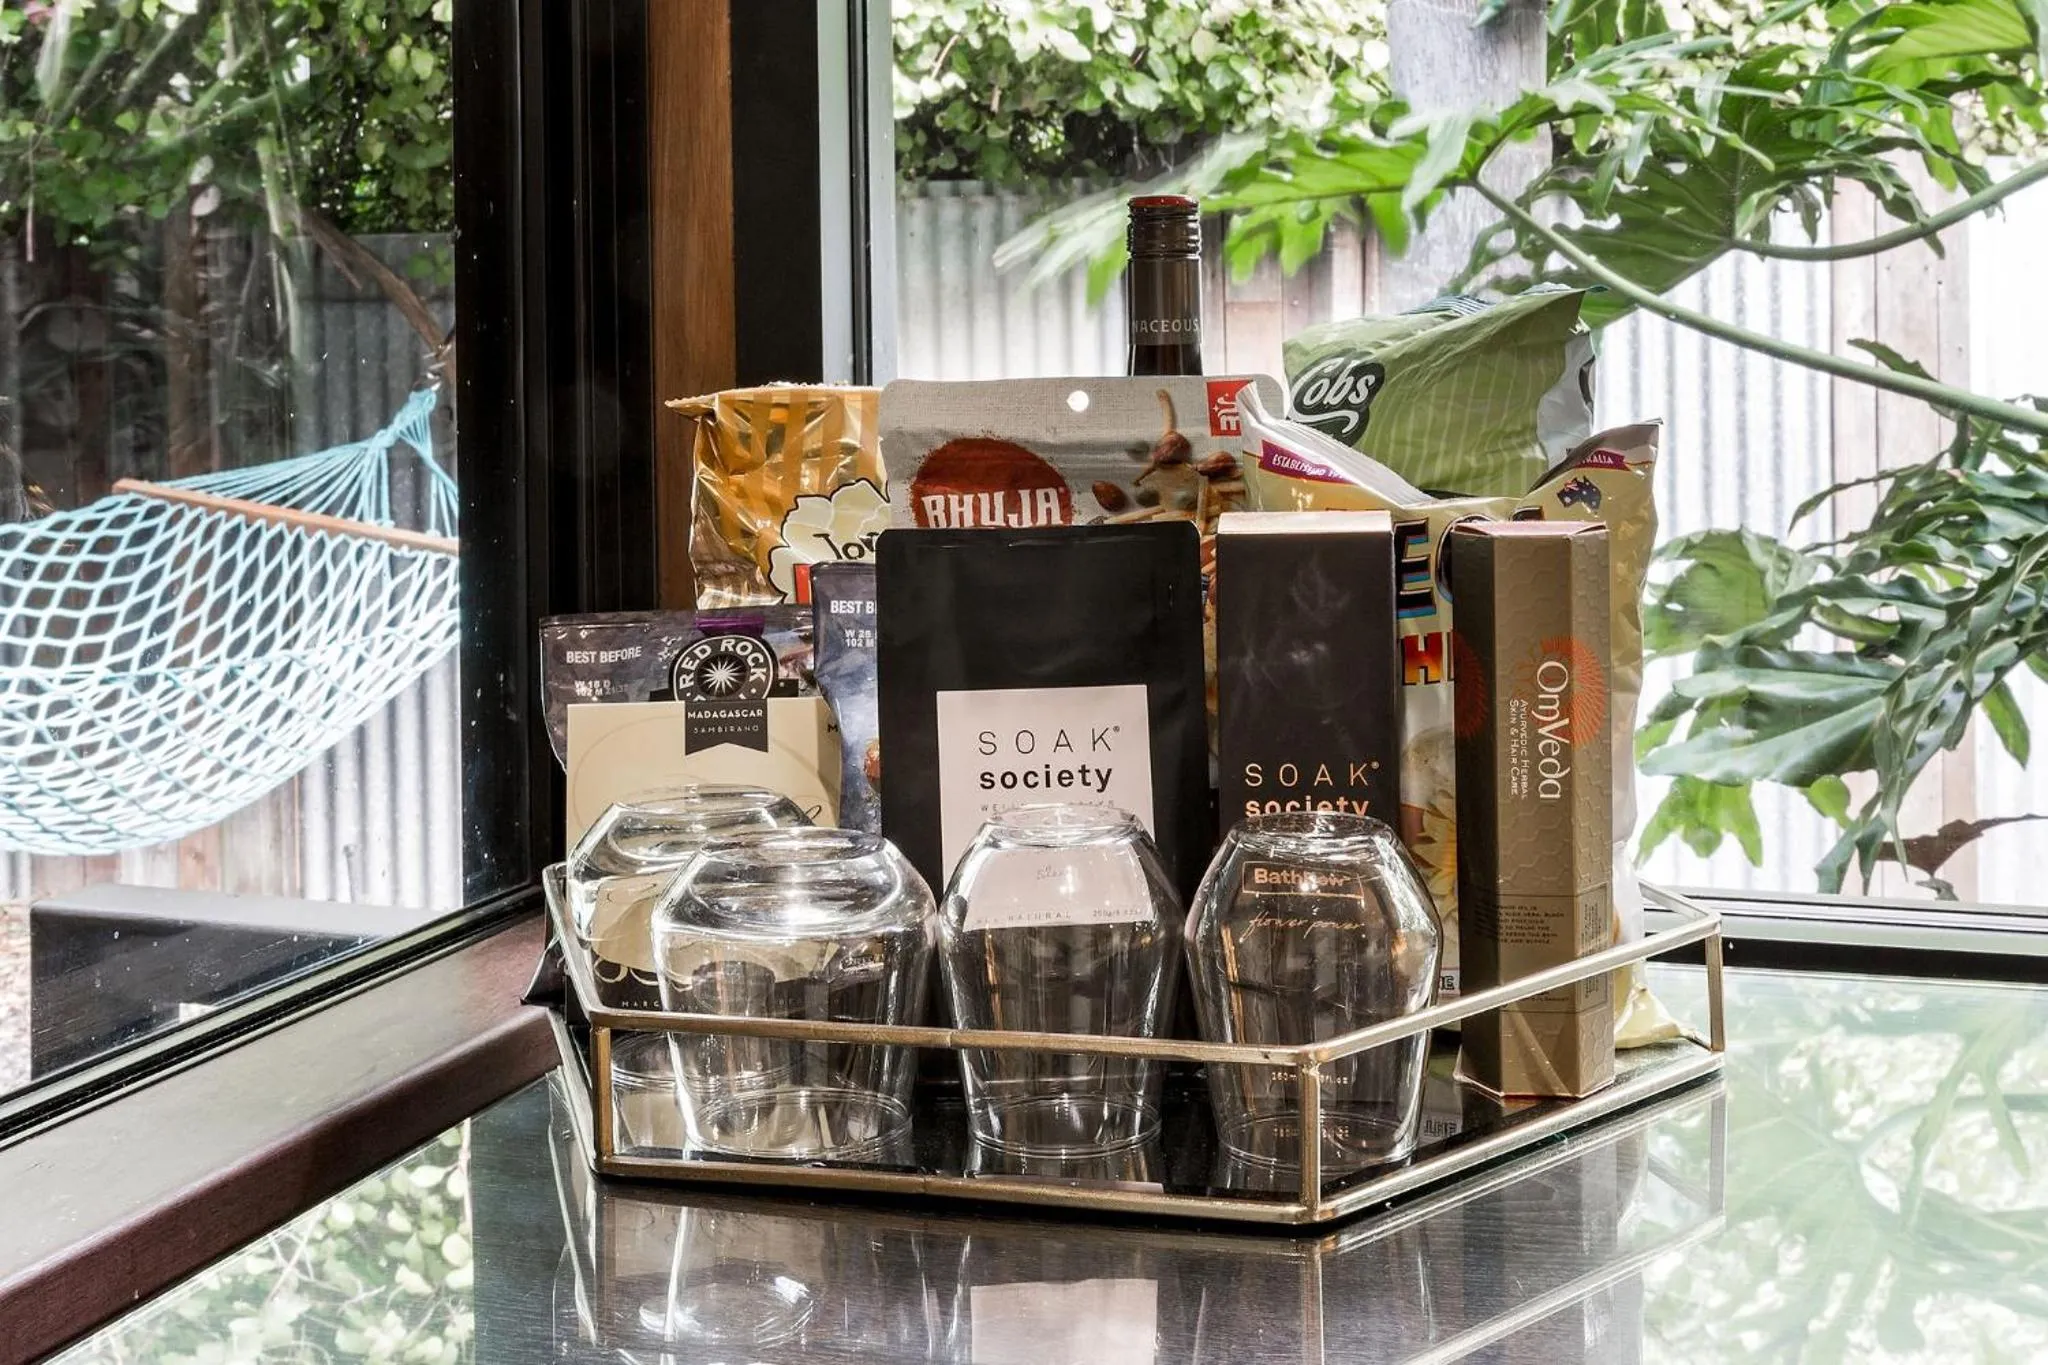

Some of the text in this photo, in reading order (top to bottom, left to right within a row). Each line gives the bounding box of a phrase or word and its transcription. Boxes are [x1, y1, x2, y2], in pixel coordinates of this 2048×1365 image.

[1289, 352, 1376, 433] Cobs
[921, 486, 1064, 529] BHUJA
[830, 599, 863, 614] BEST
[566, 646, 642, 664] BEST BEFORE
[679, 638, 768, 690] RED ROCK
[687, 708, 763, 719] MADAGASCAR
[1531, 660, 1571, 799] OmVeda
[979, 764, 1112, 793] society
[1244, 795, 1369, 818] society
